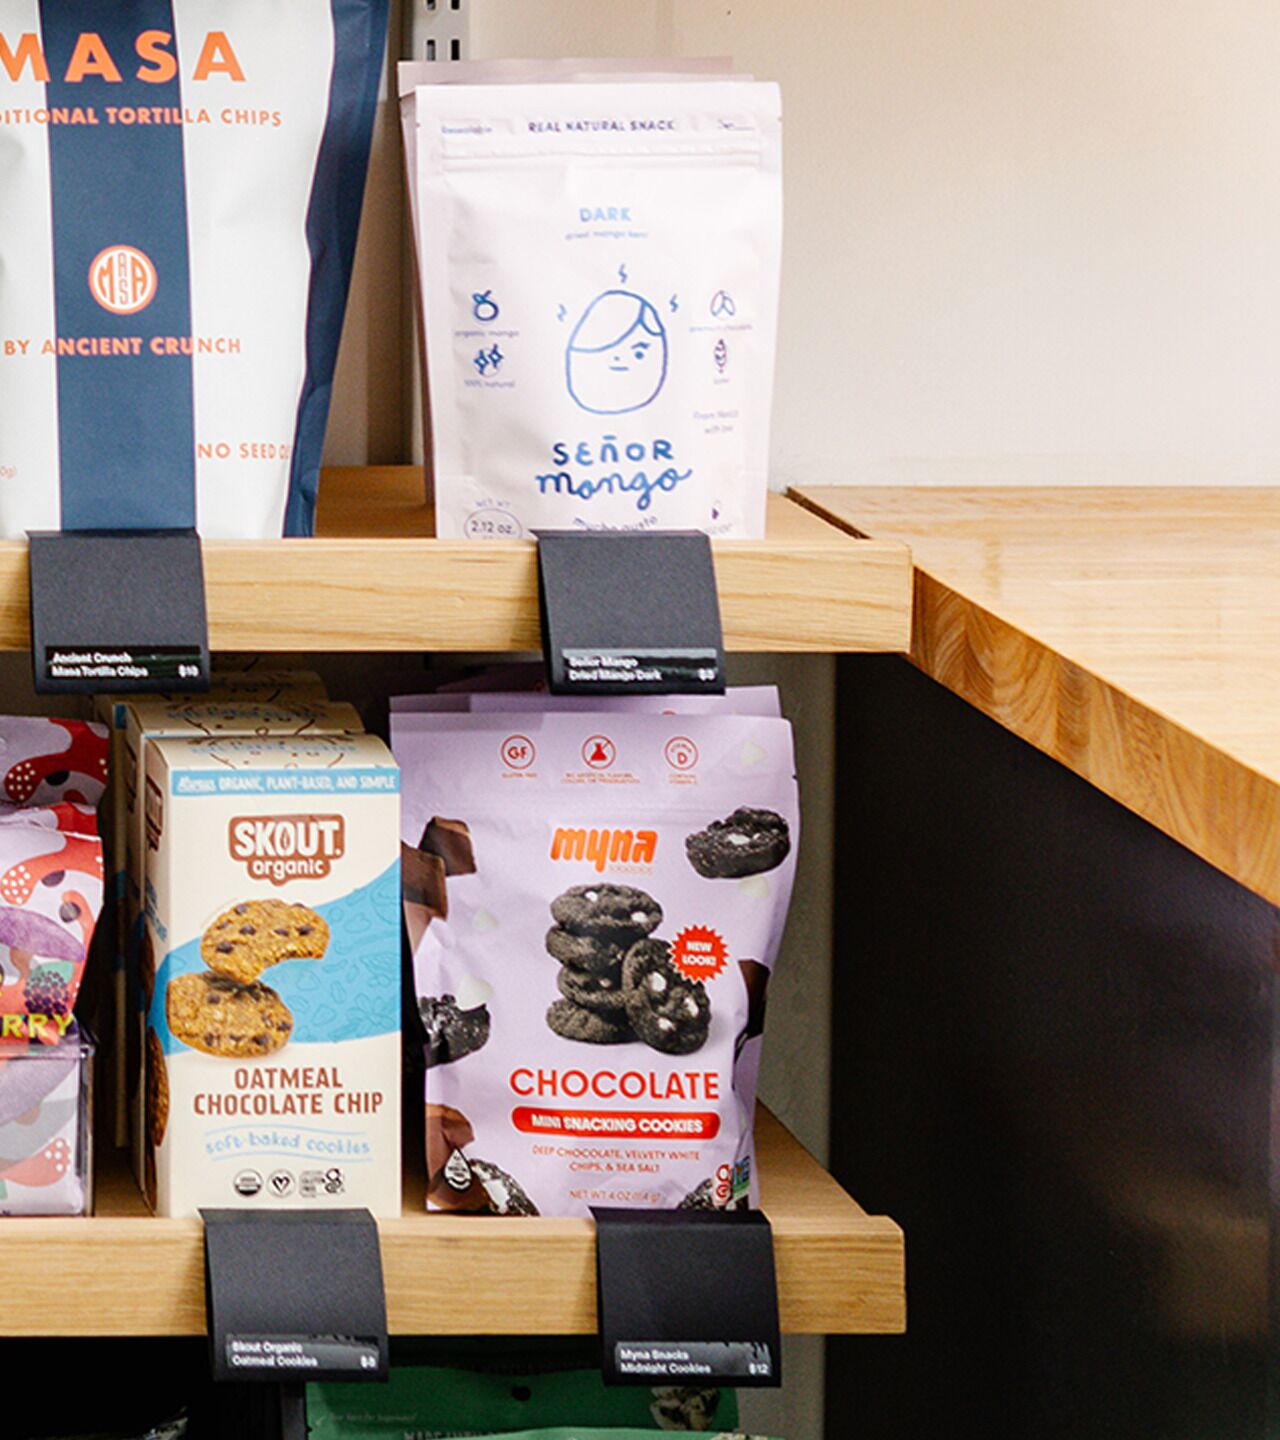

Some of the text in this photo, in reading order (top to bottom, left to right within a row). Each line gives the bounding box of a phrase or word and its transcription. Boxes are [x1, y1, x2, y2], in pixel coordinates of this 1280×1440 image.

[106, 107, 210, 125] TORTILLA
[221, 109, 282, 127] CHIPS
[579, 207, 631, 222] DARK
[5, 336, 240, 355] BY ANCIENT CRUNCH
[536, 467, 692, 511] mango
[252, 860, 323, 880] organic
[687, 941, 711, 952] NEW
[682, 954, 716, 967] LOOK!
[234, 1067, 343, 1090] OATMEAL
[510, 1068, 719, 1100] CHOCOLATE
[193, 1092, 383, 1115] CHOCOLATE CHIP
[531, 1114, 703, 1133] MINI SNACKING COOKIES
[620, 1362, 666, 1374] Midnight
[668, 1363, 711, 1374] Cookies
